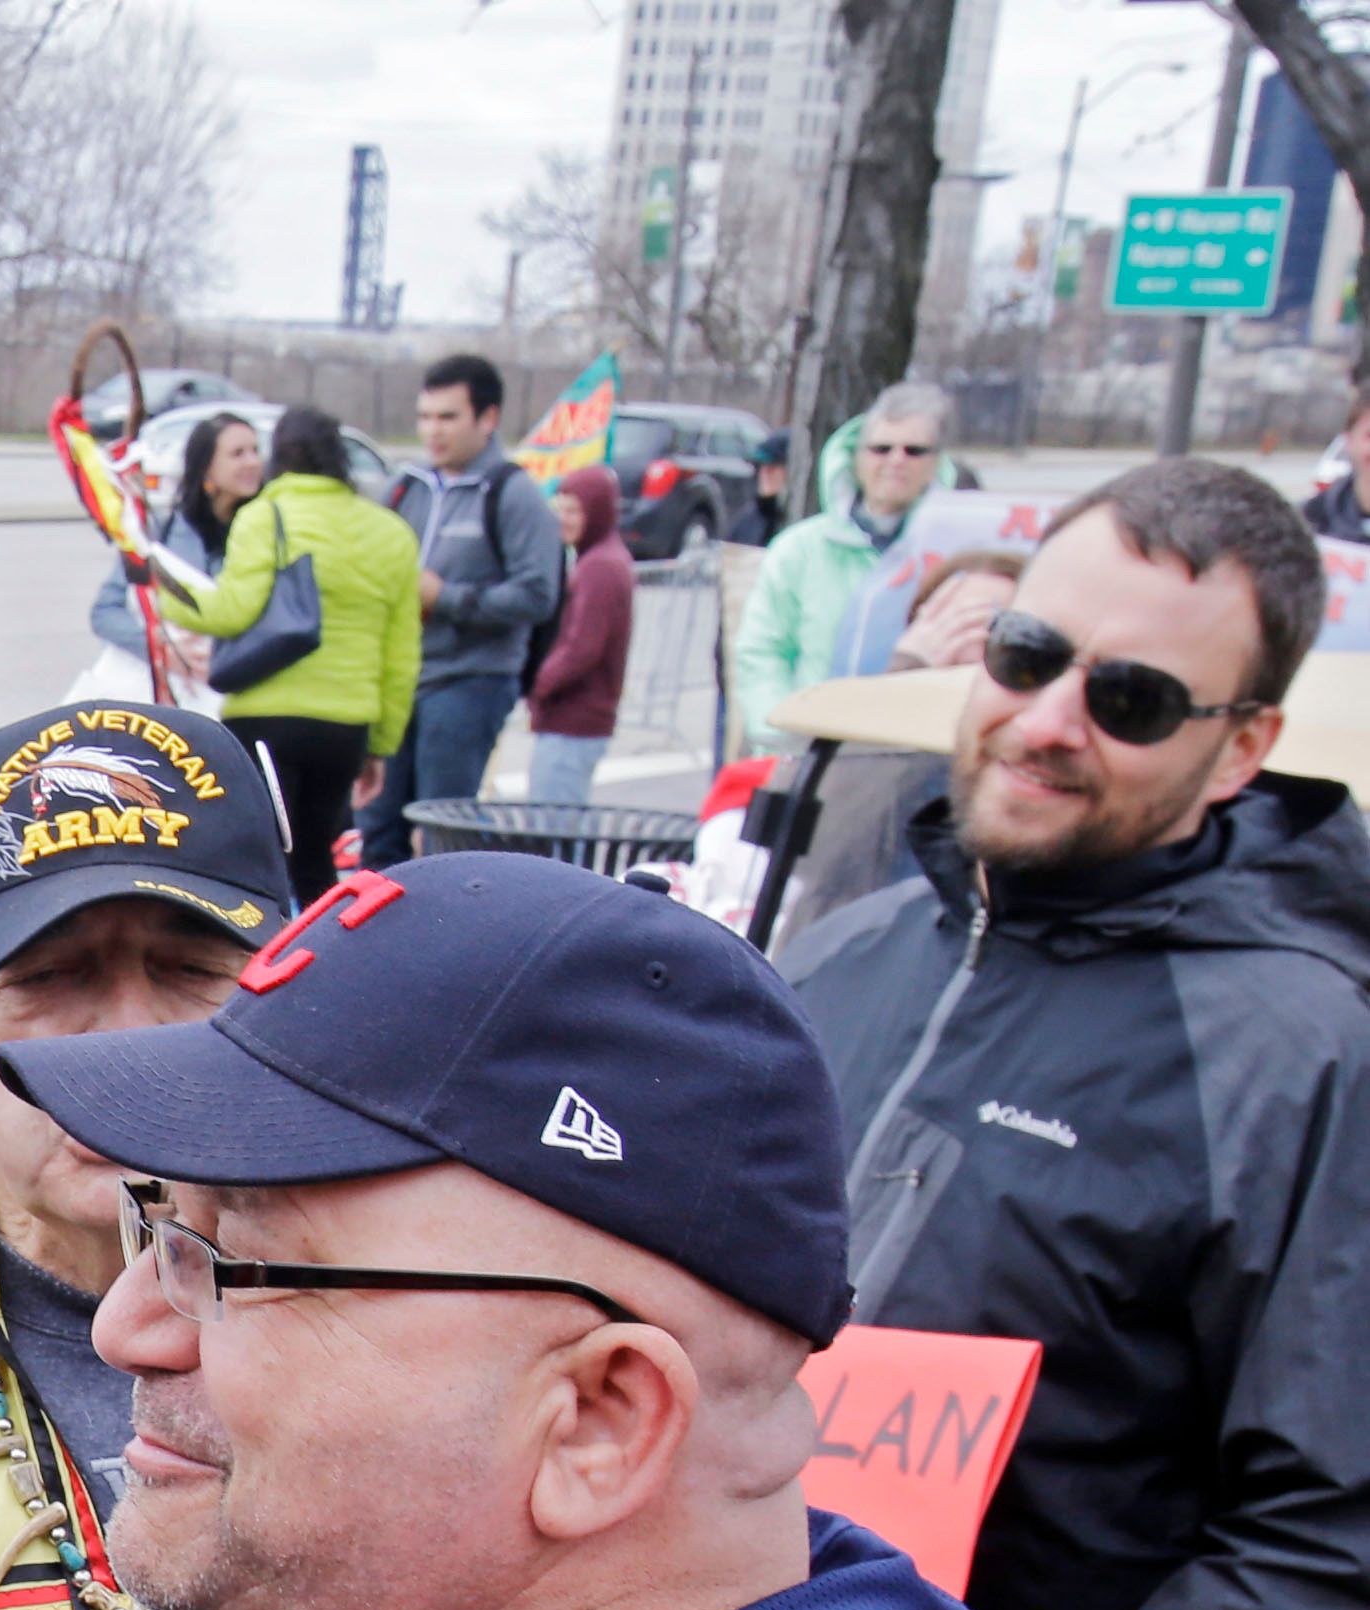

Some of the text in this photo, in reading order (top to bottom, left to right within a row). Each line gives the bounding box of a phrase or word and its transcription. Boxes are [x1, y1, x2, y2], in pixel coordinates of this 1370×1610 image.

[76, 709, 225, 800] VETERAN
[18, 806, 190, 865] ARMY
[998, 1105, 1077, 1149] Columbia
